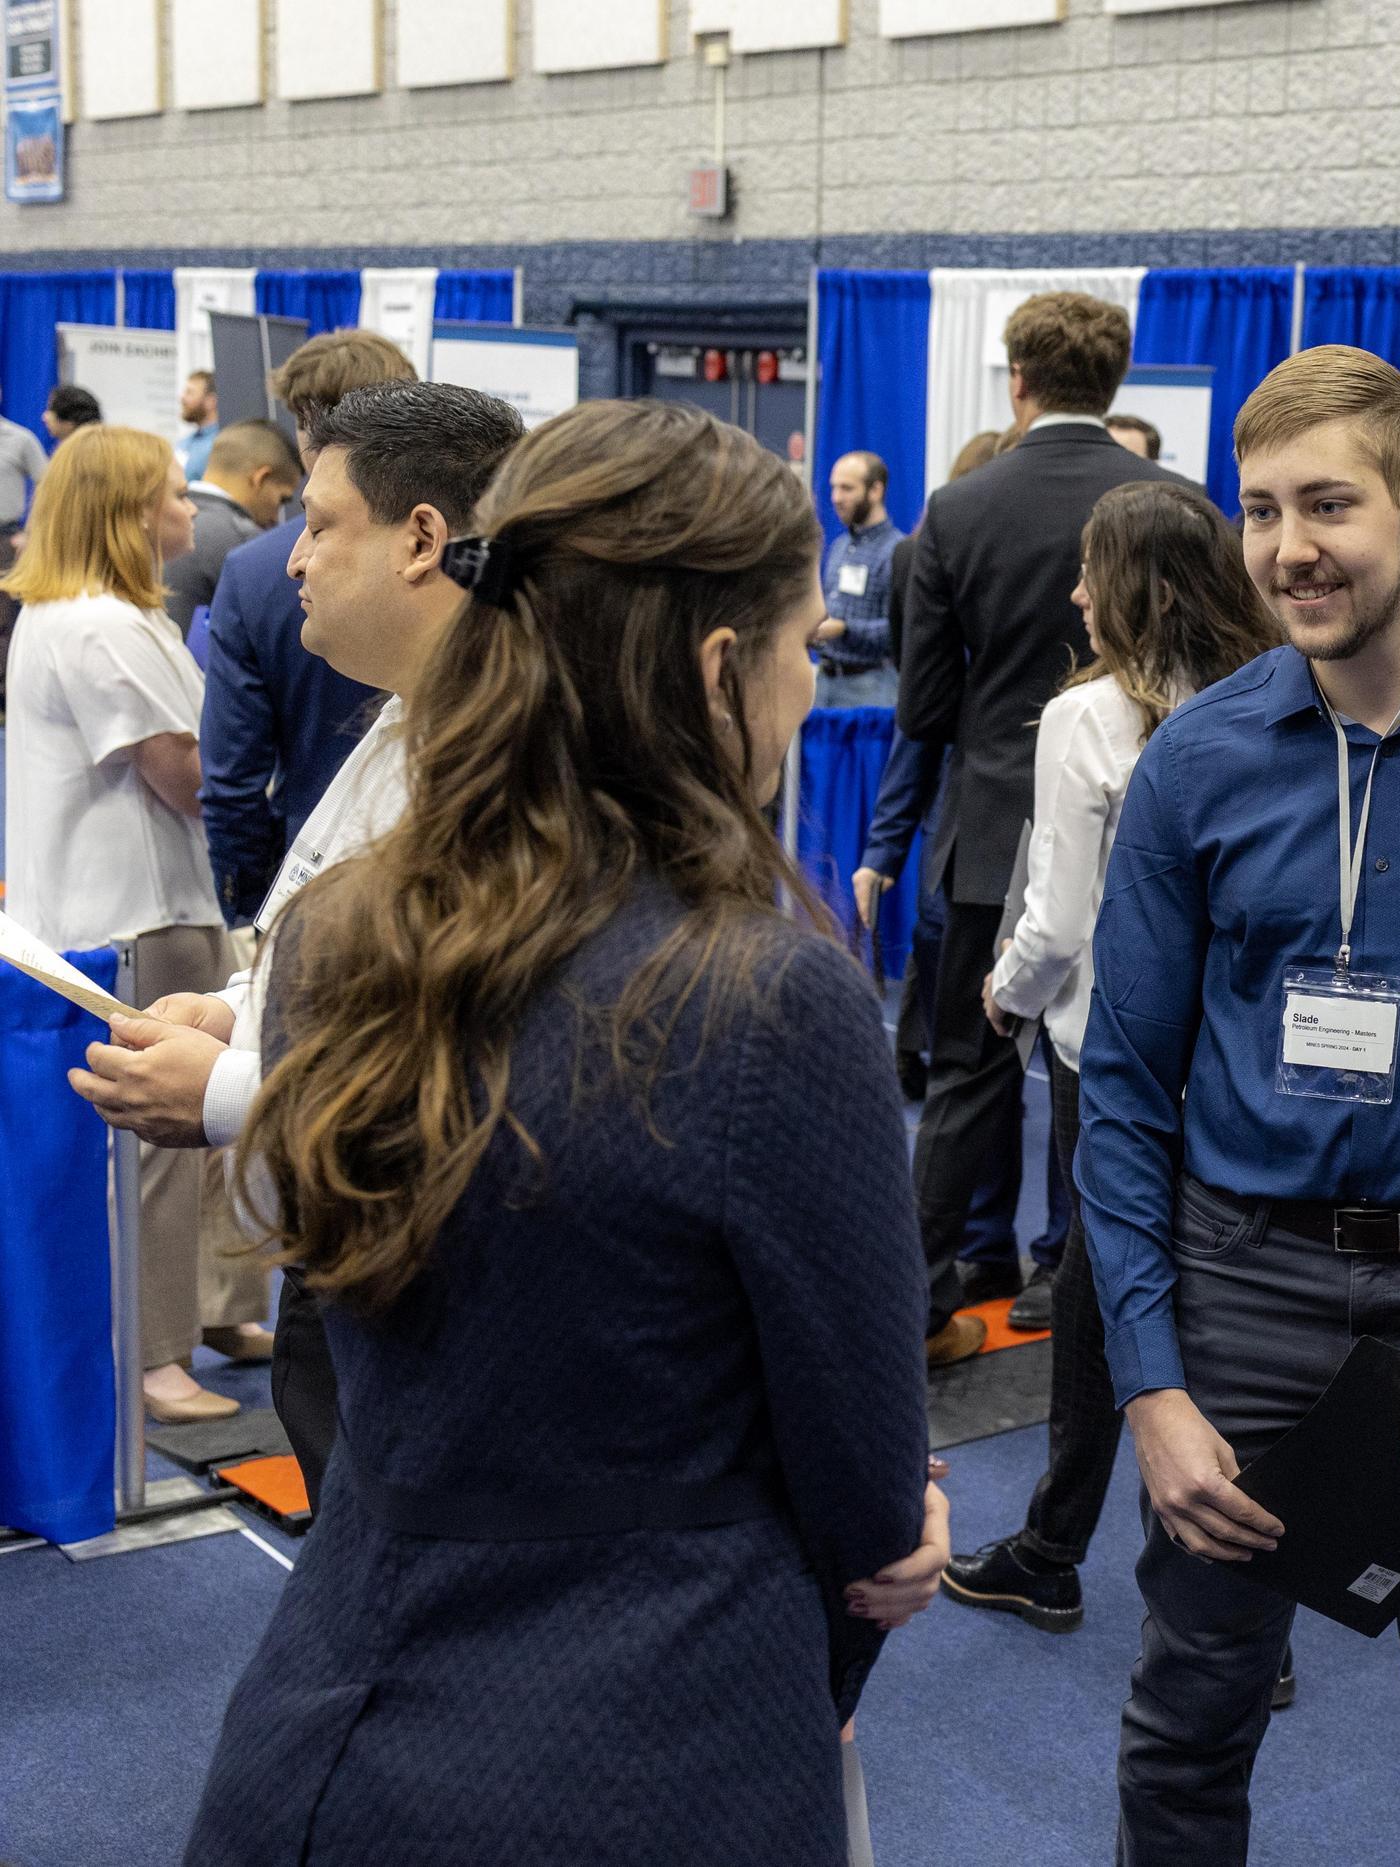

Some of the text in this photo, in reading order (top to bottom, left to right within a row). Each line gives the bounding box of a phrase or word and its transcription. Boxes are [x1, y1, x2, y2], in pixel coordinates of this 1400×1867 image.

[1293, 1013, 1319, 1024] Slade
[1292, 1023, 1318, 1032] Petroleum
[1318, 1026, 1350, 1036] Engineering
[1354, 1030, 1377, 1038] Masters
